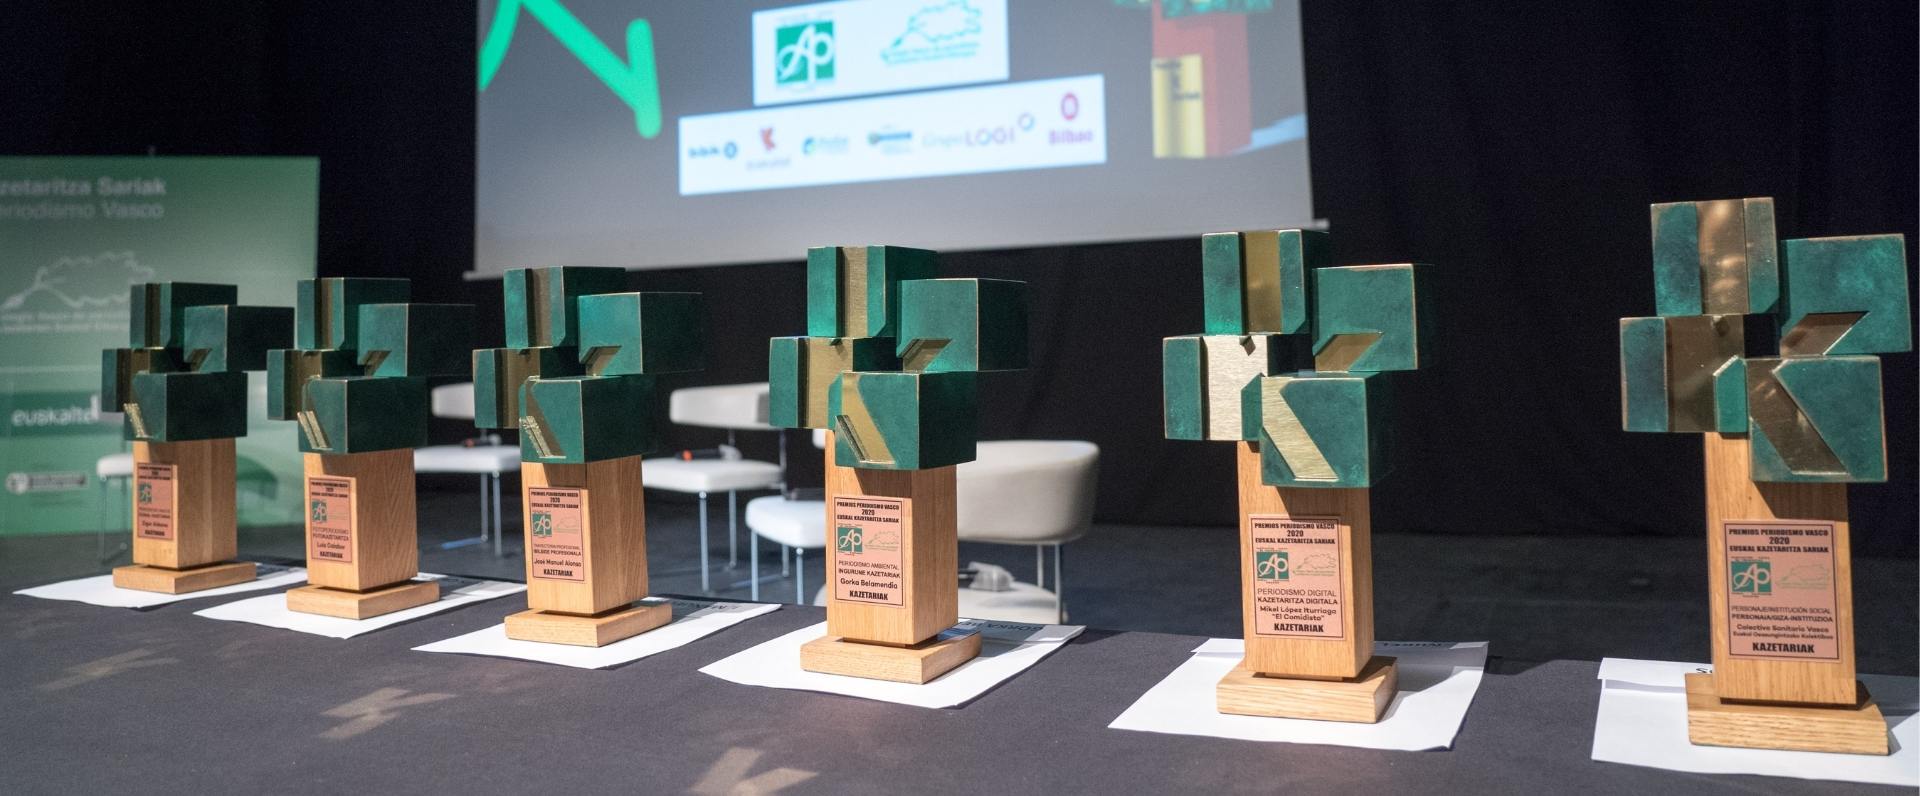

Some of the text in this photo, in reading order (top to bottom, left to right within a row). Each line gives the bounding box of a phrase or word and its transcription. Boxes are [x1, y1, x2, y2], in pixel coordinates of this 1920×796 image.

[1048, 129, 1093, 146] Bilbao
[98, 177, 166, 196] Sariak
[101, 201, 164, 219] Vasco
[849, 590, 888, 600] KAZETARIAK
[1274, 623, 1324, 632] KAZETARIAK
[1752, 643, 1815, 653] KAZETARIAK
